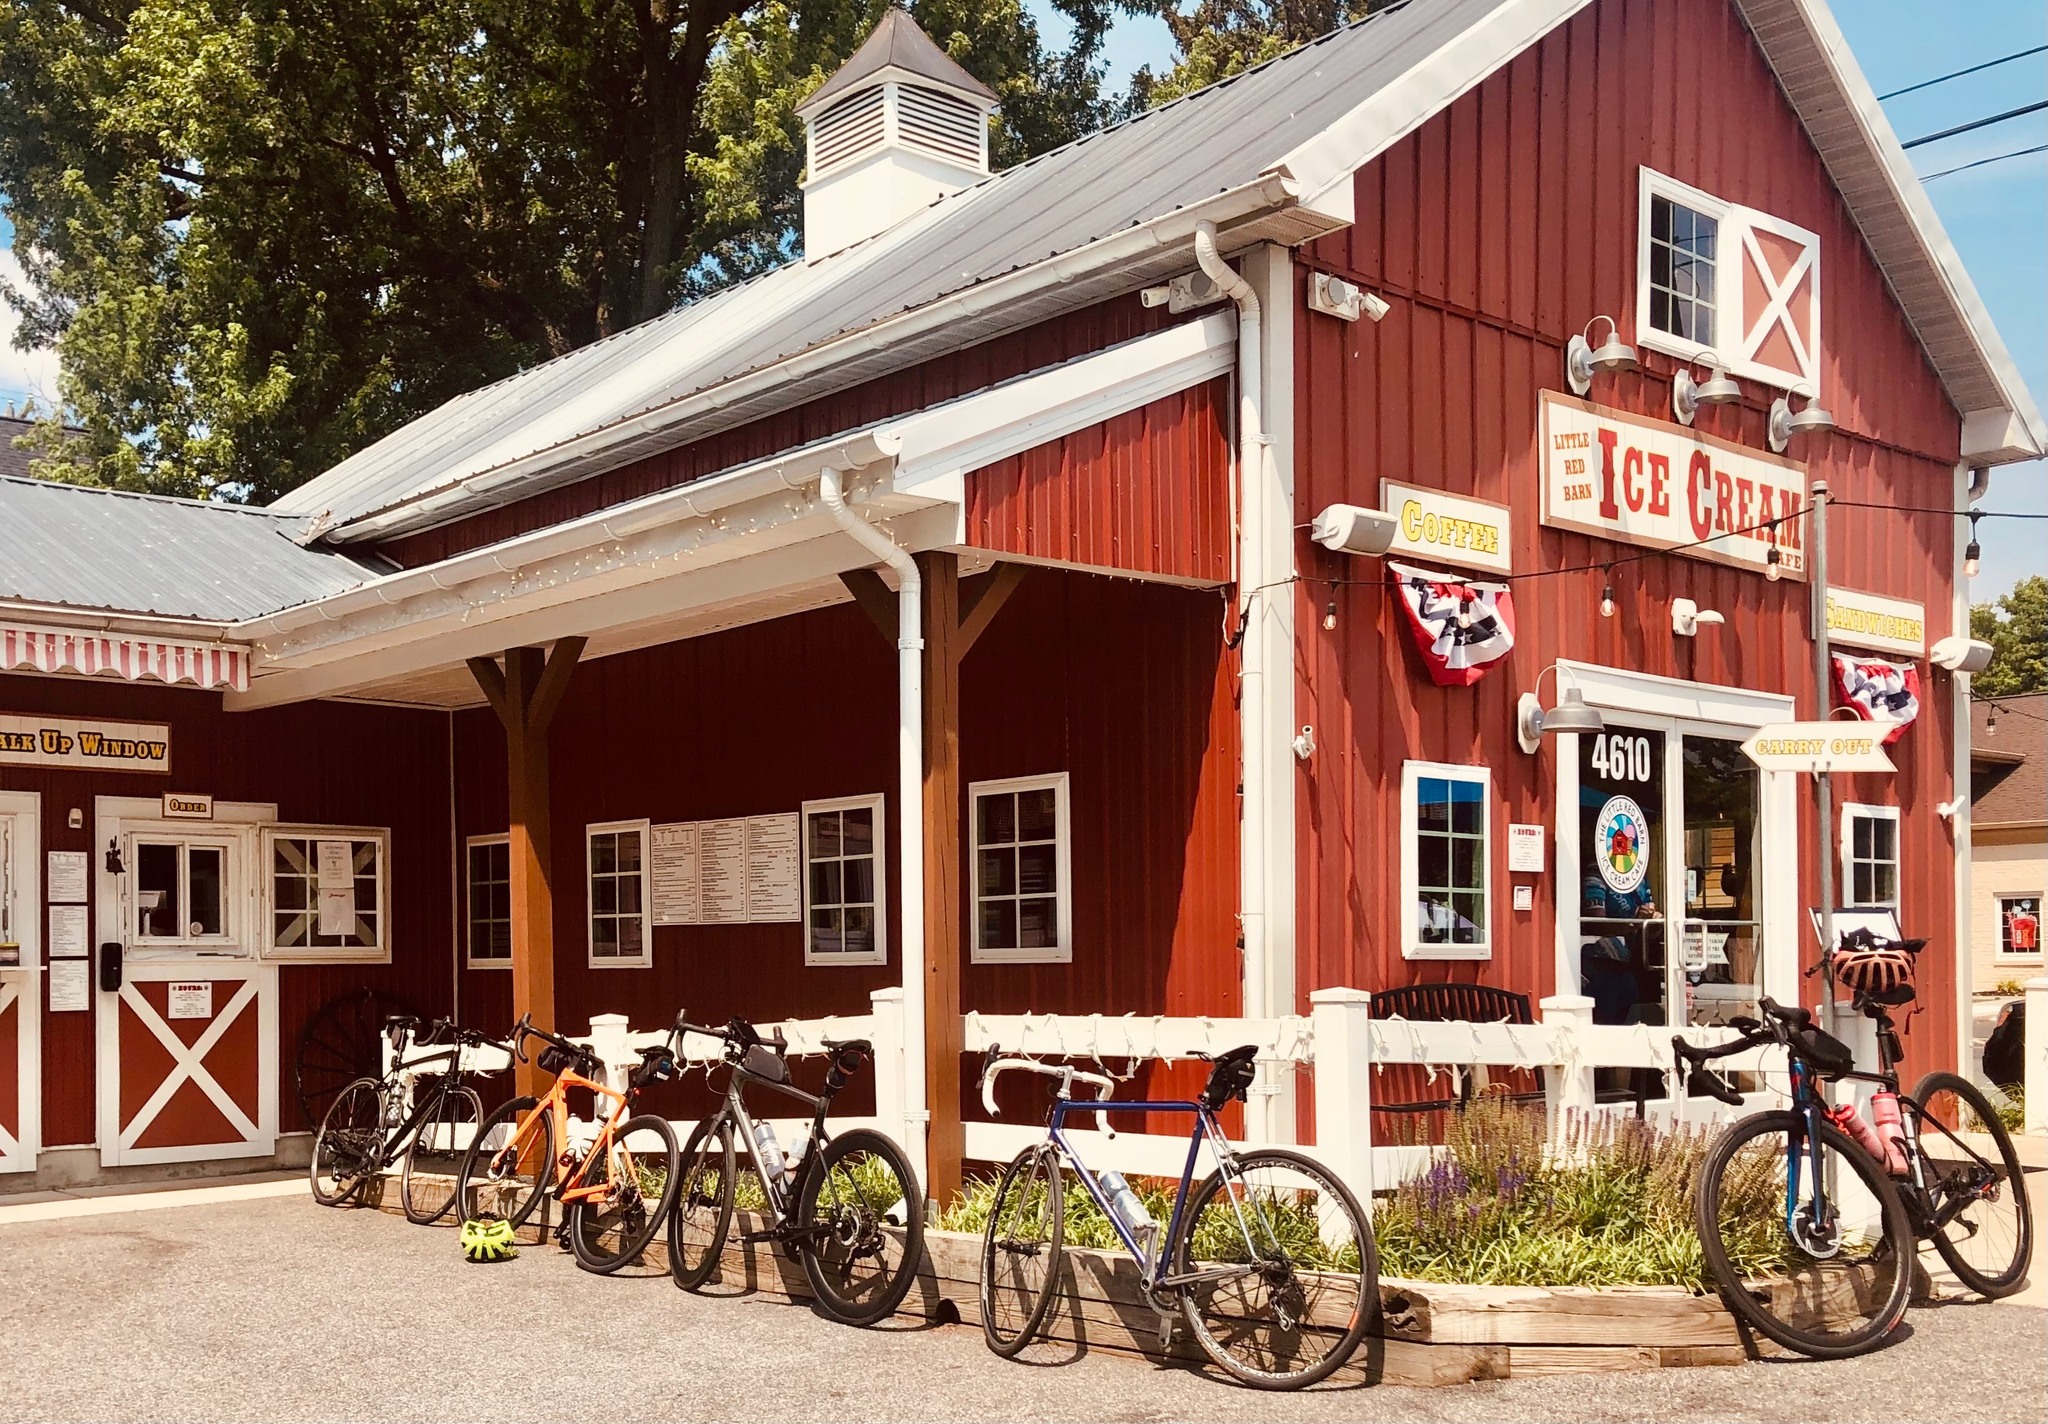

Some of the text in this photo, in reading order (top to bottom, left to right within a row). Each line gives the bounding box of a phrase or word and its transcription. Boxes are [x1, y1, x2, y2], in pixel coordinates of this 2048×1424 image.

[1553, 432, 1589, 450] LITTLE
[1564, 459, 1585, 475] RED
[1563, 483, 1592, 501] BARN
[1598, 427, 1801, 550] ICE CREAM
[1401, 499, 1498, 555] COFFEE
[1778, 551, 1801, 569] AFE
[0, 729, 166, 760] ALK UP WINDOW
[1755, 738, 1873, 756] CARRY OUT
[1592, 733, 1650, 782] 4610
[169, 798, 207, 813] ORDER
[1635, 816, 1645, 845] BARN
[1610, 871, 1630, 885] CREAM
